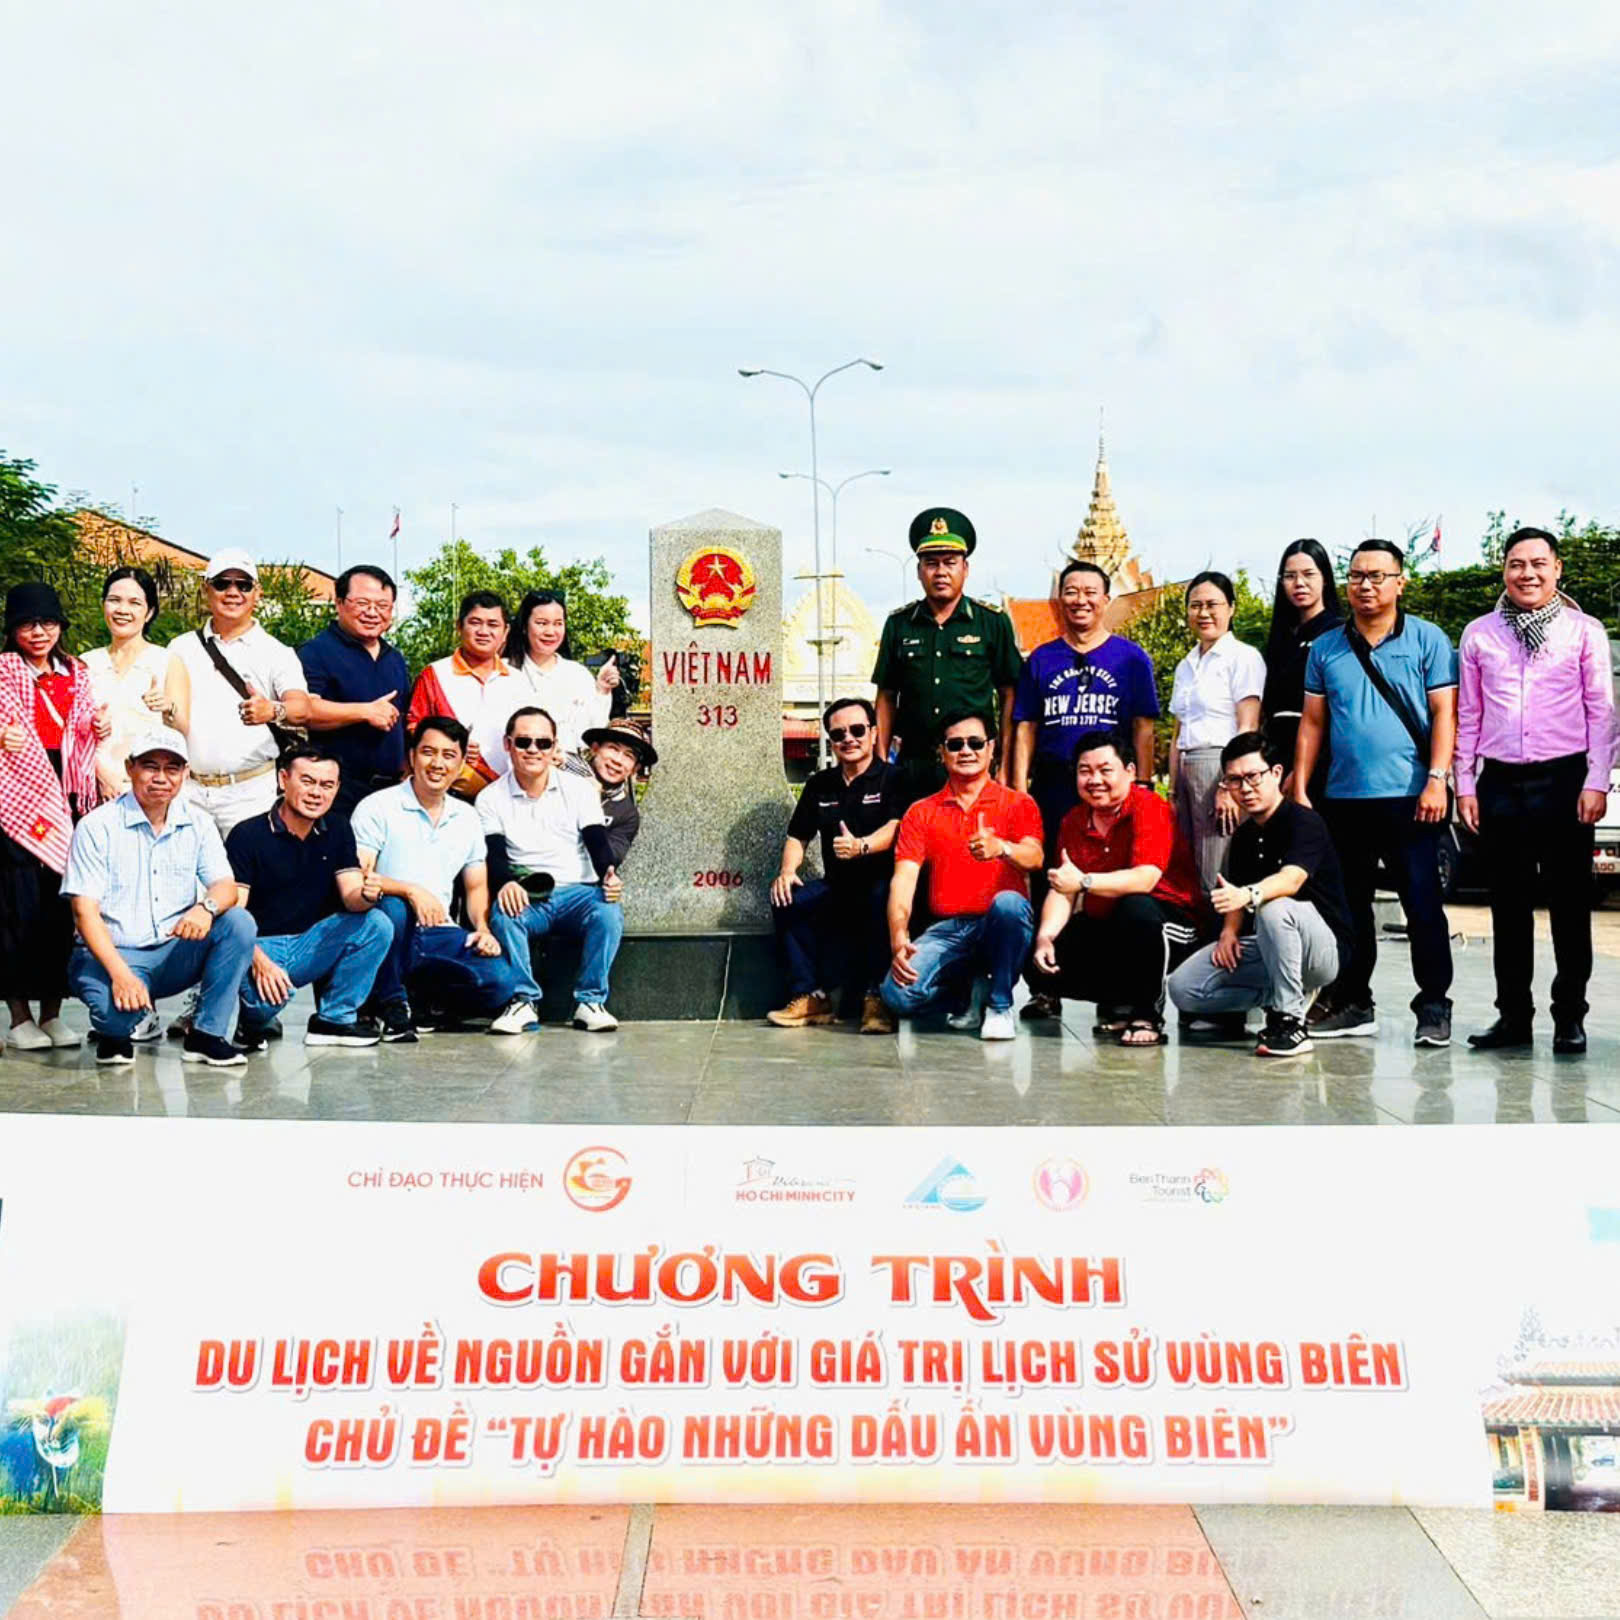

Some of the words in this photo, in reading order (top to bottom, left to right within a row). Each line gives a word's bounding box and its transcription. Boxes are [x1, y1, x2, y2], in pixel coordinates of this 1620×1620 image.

[663, 641, 711, 694] VIỆT
[716, 651, 772, 684] NAM
[697, 704, 739, 726] 313
[1044, 694, 1071, 717] NEW
[693, 870, 744, 887] 2006
[347, 1166, 383, 1188] CHỈ
[389, 1171, 434, 1193] ĐẠO
[440, 1171, 494, 1193] THỰC
[499, 1167, 544, 1193] HIỆN
[735, 1190, 757, 1202] HO
[759, 1190, 783, 1202] CHI
[785, 1190, 820, 1202] MINH
[822, 1190, 856, 1202] CITY
[478, 1244, 841, 1303] CHƯƠNG
[871, 1239, 1122, 1321] TRÌNH
[196, 1339, 257, 1387] DU
[272, 1338, 371, 1396] LỊCH
[387, 1323, 441, 1385] VỀ
[454, 1322, 603, 1385] NGUỒN
[620, 1324, 706, 1384] GẮN
[722, 1331, 793, 1384] VỚI
[810, 1331, 882, 1384] GIÁ
[898, 1339, 964, 1397] TRỊ
[982, 1339, 1077, 1397] LỊCH
[1093, 1328, 1152, 1385] SỬ
[1166, 1333, 1284, 1385] VÙNG
[1299, 1333, 1402, 1386] BIÊN
[304, 1406, 397, 1463] CHỦ
[411, 1402, 470, 1462] ĐỀ
[578, 1407, 666, 1460] HÀO
[683, 1406, 834, 1459] NHỮNG
[851, 1399, 937, 1459] DẤU
[955, 1398, 1012, 1458] ẤN
[1028, 1407, 1148, 1459] VÙNG
